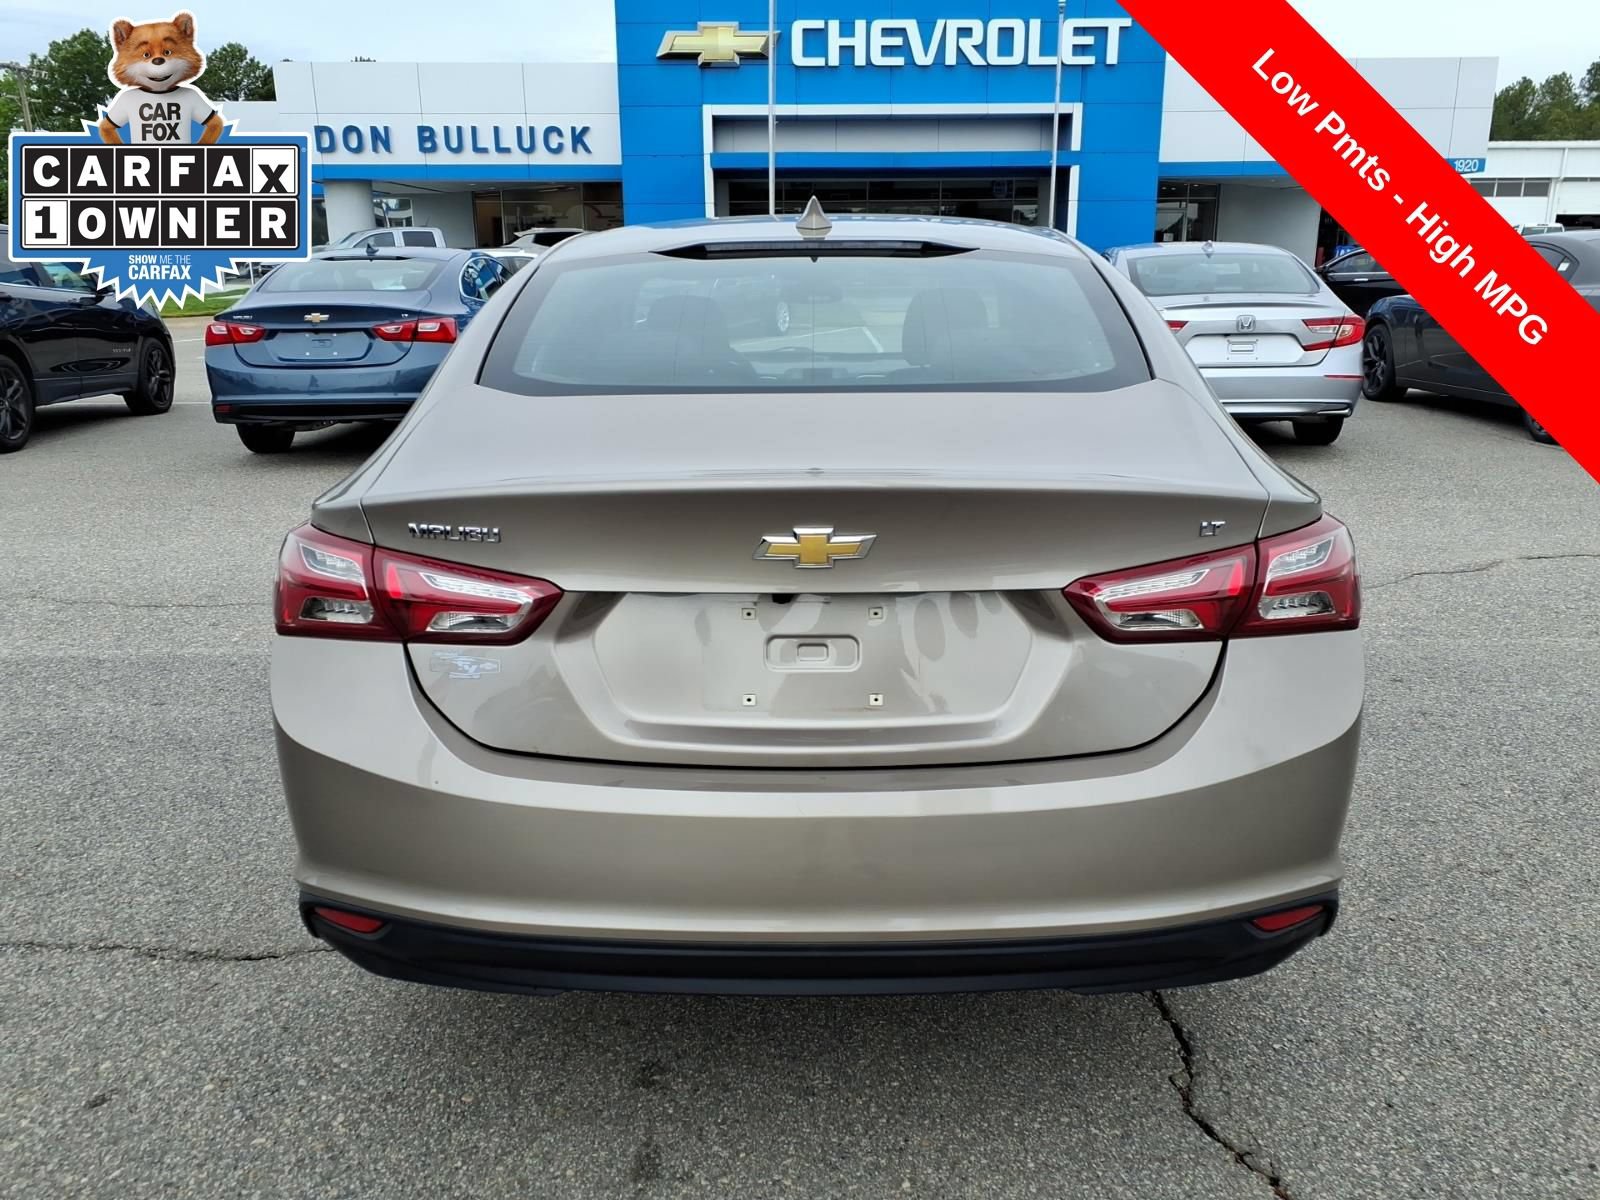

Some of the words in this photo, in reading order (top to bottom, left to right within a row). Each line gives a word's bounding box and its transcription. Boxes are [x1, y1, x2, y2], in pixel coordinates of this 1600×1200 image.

[791, 18, 1132, 67] CHEVROLET
[313, 124, 393, 154] DON
[416, 124, 592, 155] BULLUCK
[1453, 158, 1479, 173] 1920
[408, 522, 502, 543] MALIBU
[1199, 520, 1226, 537] LT
